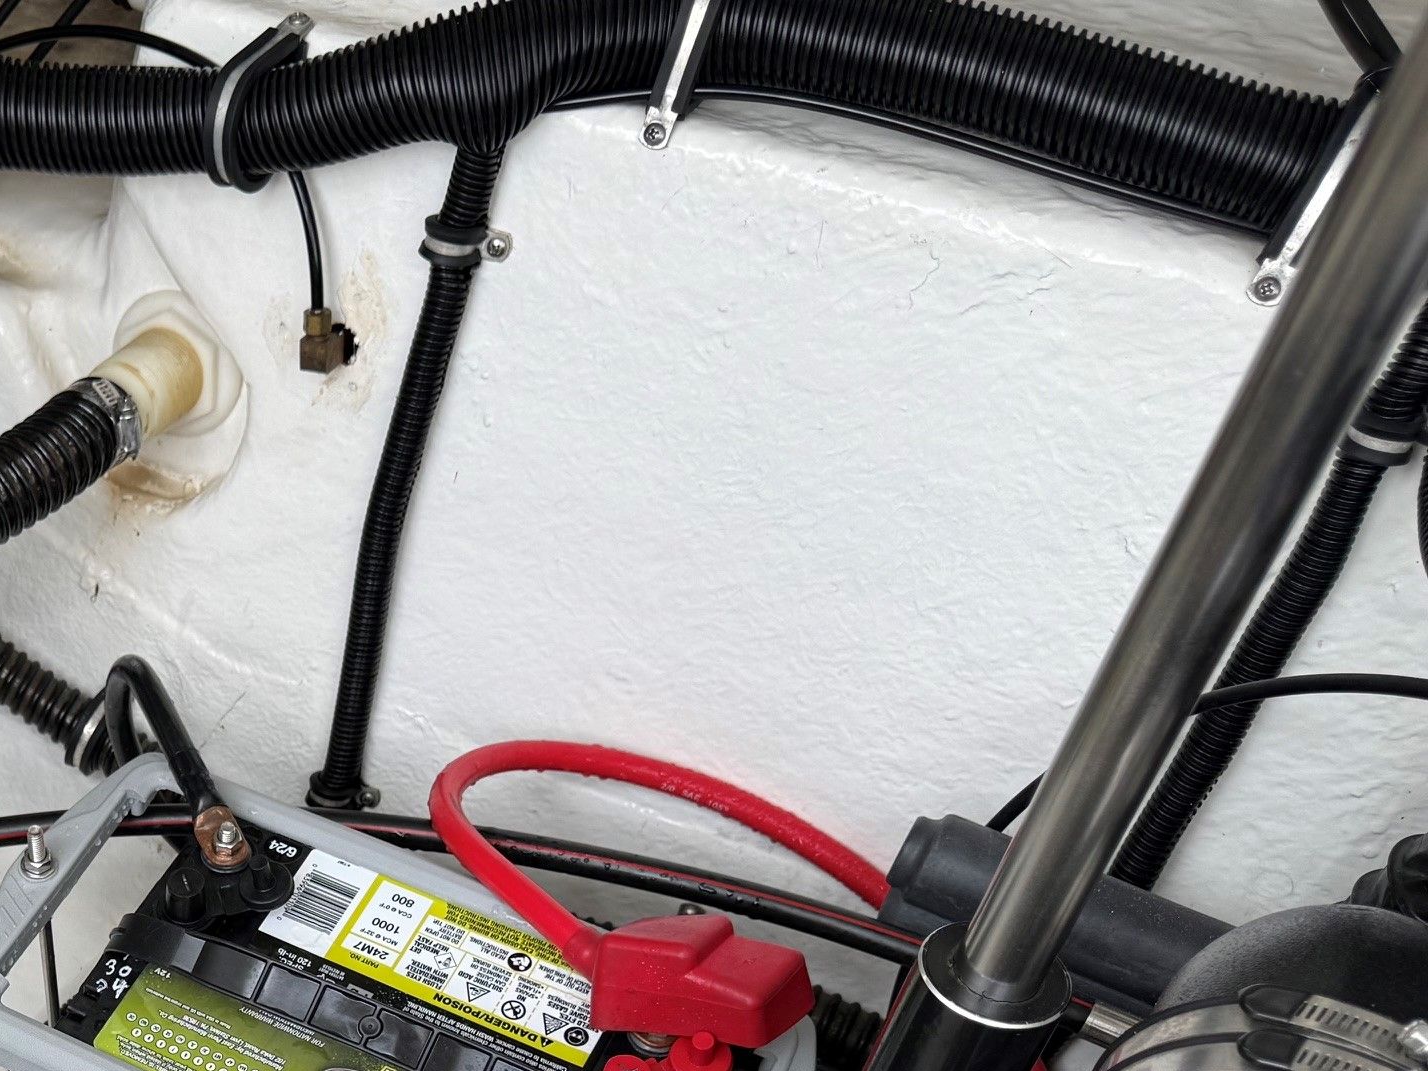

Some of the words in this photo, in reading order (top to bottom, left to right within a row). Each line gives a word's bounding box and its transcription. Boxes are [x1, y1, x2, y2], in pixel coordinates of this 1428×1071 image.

[267, 836, 298, 860] 6/24
[390, 891, 415, 909] 800
[389, 905, 397, 913] @
[396, 908, 413, 919] CCA
[443, 913, 458, 923] NOT
[456, 918, 467, 927] DO
[358, 925, 375, 937] 32°F
[370, 915, 401, 935] 1000
[442, 922, 456, 932] NOT
[455, 927, 465, 935] DO
[458, 912, 506, 938] RECOMMENDED
[489, 919, 522, 938] CHARGING
[373, 931, 382, 939] @
[423, 926, 440, 937] OPEN
[438, 932, 451, 941] NOT
[488, 931, 500, 940] OR
[504, 931, 520, 943] NOT
[381, 935, 398, 947] MCA
[415, 933, 434, 946] FAST.
[449, 936, 460, 945] DO
[467, 934, 509, 957] INSTRUCTIONS.
[499, 935, 534, 955] EXPLOSION
[352, 938, 389, 961] 24M7
[408, 944, 422, 955] GET
[412, 939, 440, 955] MEDICAL
[432, 940, 450, 952] HELP
[479, 945, 491, 955] ALL
[275, 946, 298, 961] in-lb
[347, 951, 361, 961] NO.
[489, 949, 506, 961] READ
[296, 955, 313, 968] 120
[360, 956, 379, 969] PART
[409, 958, 433, 973] WATER.
[469, 961, 479, 970] OR
[549, 956, 559, 965] OF
[104, 958, 132, 977] 30
[152, 965, 172, 979] 12V
[404, 962, 446, 985] IMMEDIATELY
[431, 967, 449, 979] WITH
[478, 965, 510, 982] BLINDNESS
[491, 964, 513, 977] SEVERE
[404, 970, 422, 982] EYES
[456, 969, 474, 981] ACID
[475, 970, 494, 982] CAUSE
[516, 974, 541, 988] SMOKING
[543, 972, 556, 981] THE
[554, 976, 564, 985] OF
[420, 976, 443, 991] FLUSH
[472, 975, 504, 993] SULFURIC
[493, 978, 507, 988] CAN
[517, 981, 538, 994] FLAMES
[514, 986, 535, 999] SPARKS
[573, 984, 589, 995] KEEP
[515, 993, 527, 1002] NO
[546, 993, 577, 1010] BLINDNESS
[401, 1004, 410, 1013] of
[404, 999, 437, 1018] HANDLING.
[546, 999, 568, 1013] GASES
[237, 1004, 274, 1025] WARRANTY
[408, 1007, 425, 1019] State
[423, 1014, 435, 1023] the
[431, 991, 538, 1043] DANGER/POISON
[435, 1012, 456, 1026] AFTER
[166, 1013, 208, 1037] Manufacturing
[199, 1021, 209, 1030] PA
[433, 1018, 441, 1026] to
[439, 1021, 460, 1034] known
[454, 1020, 477, 1035] HANDS
[272, 1019, 312, 1042] NATIONWIDE
[475, 1029, 495, 1042] WASH
[205, 1031, 222, 1043] Penn
[228, 1034, 244, 1046] Lyon
[310, 1036, 325, 1047] FOR
[459, 1029, 489, 1046] chemicals
[220, 1038, 235, 1050] East
[234, 1044, 245, 1054] by:
[487, 1041, 504, 1053] other
[259, 1048, 276, 1060] Deka
[502, 1048, 526, 1062] contain
[514, 1045, 534, 1058] cause
[532, 1053, 540, 1061] to
[242, 1049, 284, 1071] Manufactured
[274, 1055, 286, 1065] 102
[524, 1057, 538, 1068] also
